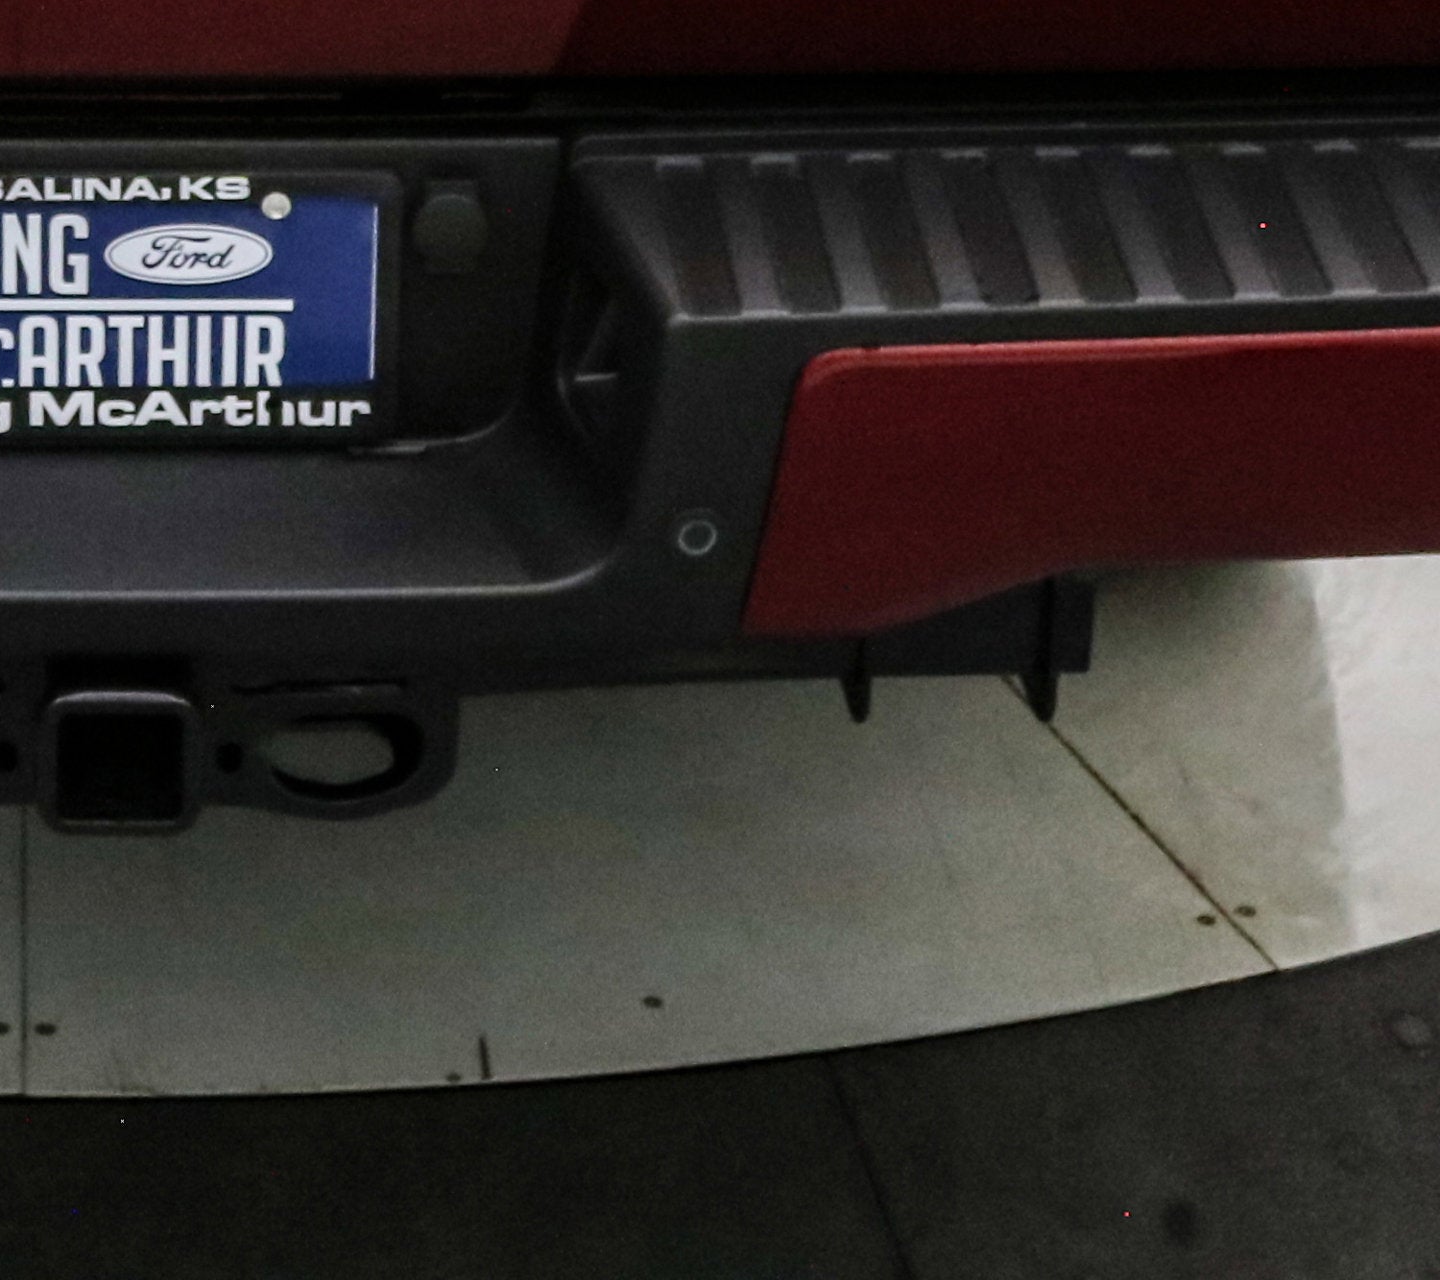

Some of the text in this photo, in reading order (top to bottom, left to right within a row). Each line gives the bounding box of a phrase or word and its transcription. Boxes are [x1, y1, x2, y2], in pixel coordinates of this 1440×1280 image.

[178, 176, 251, 202] KS
[141, 234, 235, 270] Ford
[27, 389, 372, 428] McArthur
